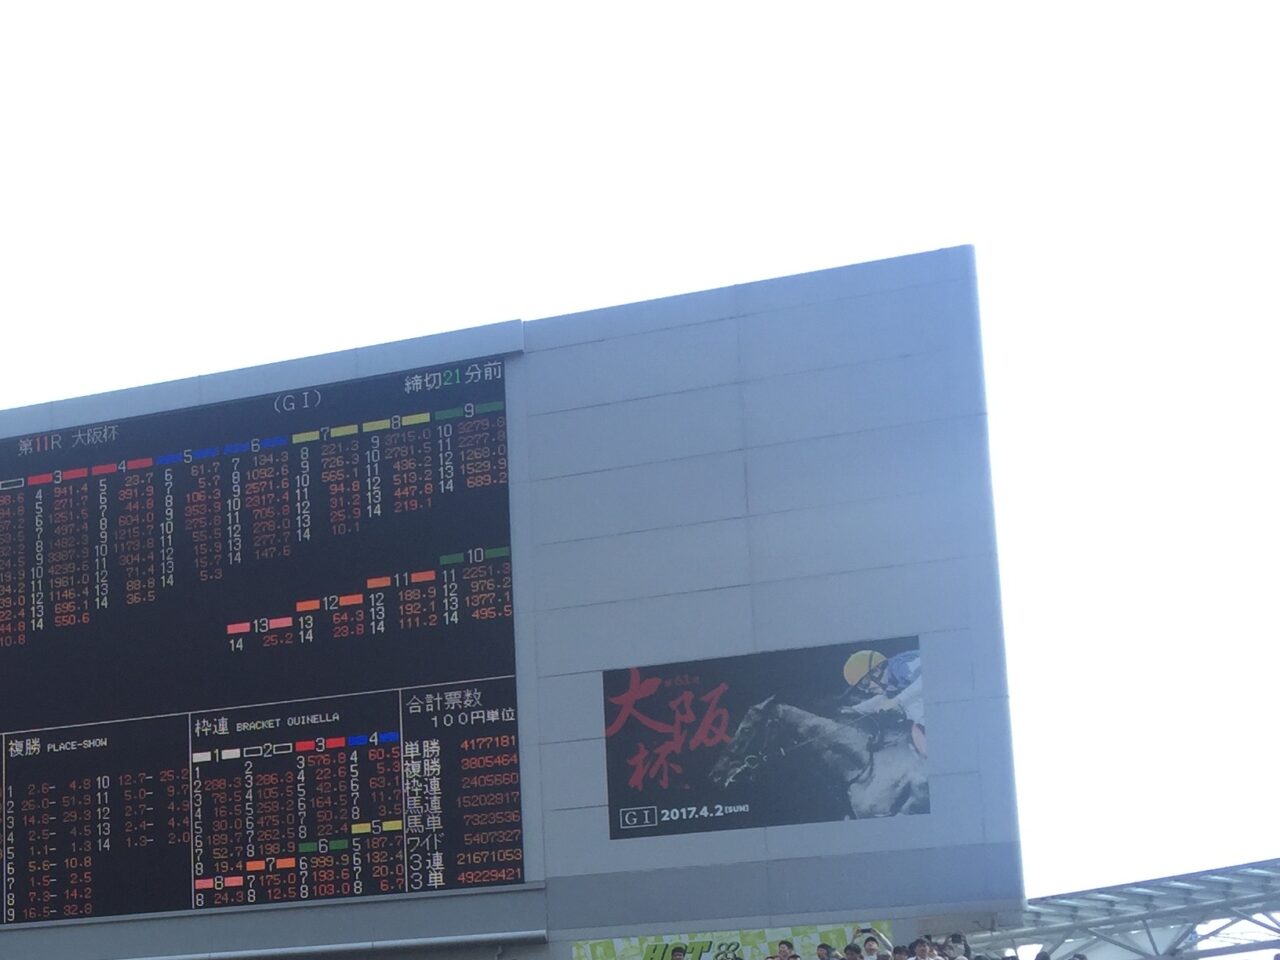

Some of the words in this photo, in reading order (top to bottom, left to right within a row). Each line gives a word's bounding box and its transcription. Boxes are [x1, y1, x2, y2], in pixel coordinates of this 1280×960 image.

[404, 360, 502, 394] 締切21分前
[18, 434, 63, 456] 第11R
[72, 425, 119, 448] 大阪杯
[467, 548, 484, 564] 10
[394, 572, 408, 587] 11
[322, 595, 338, 610] 12
[253, 618, 268, 633] 13
[230, 638, 243, 651] 14
[406, 688, 482, 714] 合計票数
[194, 717, 229, 737] 枠連
[236, 717, 281, 733] BRACKET
[287, 712, 340, 727] QUINELLA
[8, 736, 40, 758] 複勝
[47, 737, 108, 753] PLACE-SHOW
[404, 738, 440, 759] 単勝
[461, 735, 516, 751] 4177181
[404, 758, 441, 778] 複勝
[404, 776, 442, 797] 枠連
[404, 796, 442, 815] 馬連
[661, 804, 724, 821] 2017.4.2
[406, 814, 443, 833] 馬単
[407, 833, 445, 853] ワイド
[410, 851, 445, 871] 3連
[457, 848, 522, 865] 21671053
[410, 868, 445, 890] 3単
